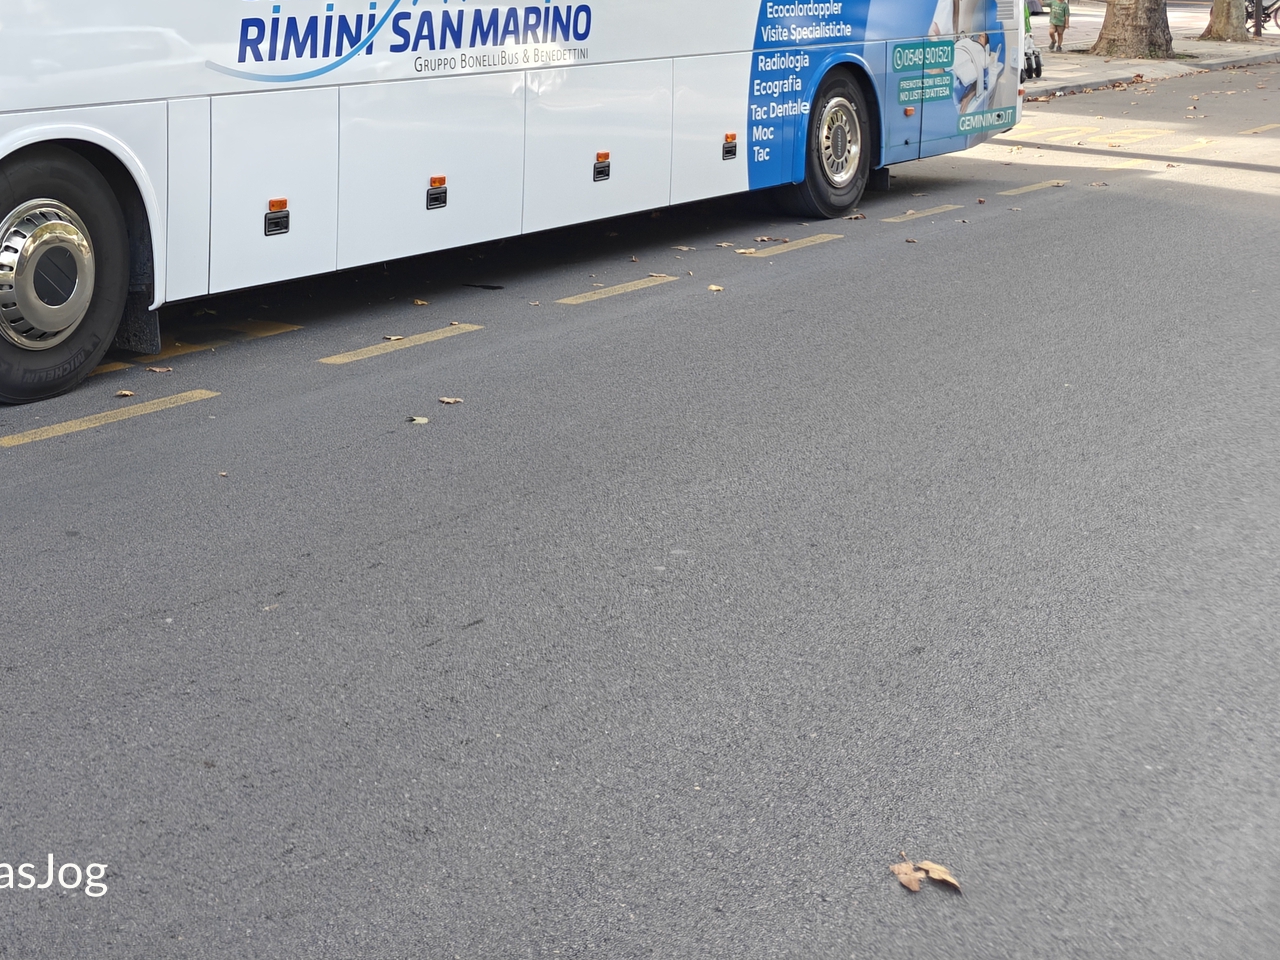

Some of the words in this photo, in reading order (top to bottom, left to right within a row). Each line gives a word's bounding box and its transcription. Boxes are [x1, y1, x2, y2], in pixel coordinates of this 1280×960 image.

[766, 0, 842, 19] Ecocolordoppler
[237, 1, 377, 63] RIMINI
[390, 9, 464, 53] SAN
[761, 24, 788, 42] Visite
[790, 21, 852, 43] Specialistiche
[522, 49, 530, 64] &
[758, 52, 810, 72] Radiologia
[903, 48, 924, 66] 0549
[925, 46, 951, 63] 901521
[754, 75, 802, 98] Ecografia
[900, 91, 909, 101] NO
[751, 104, 767, 121] Tac
[770, 98, 810, 118] Dentale
[752, 125, 775, 142] Moc
[753, 146, 770, 162] Tac
